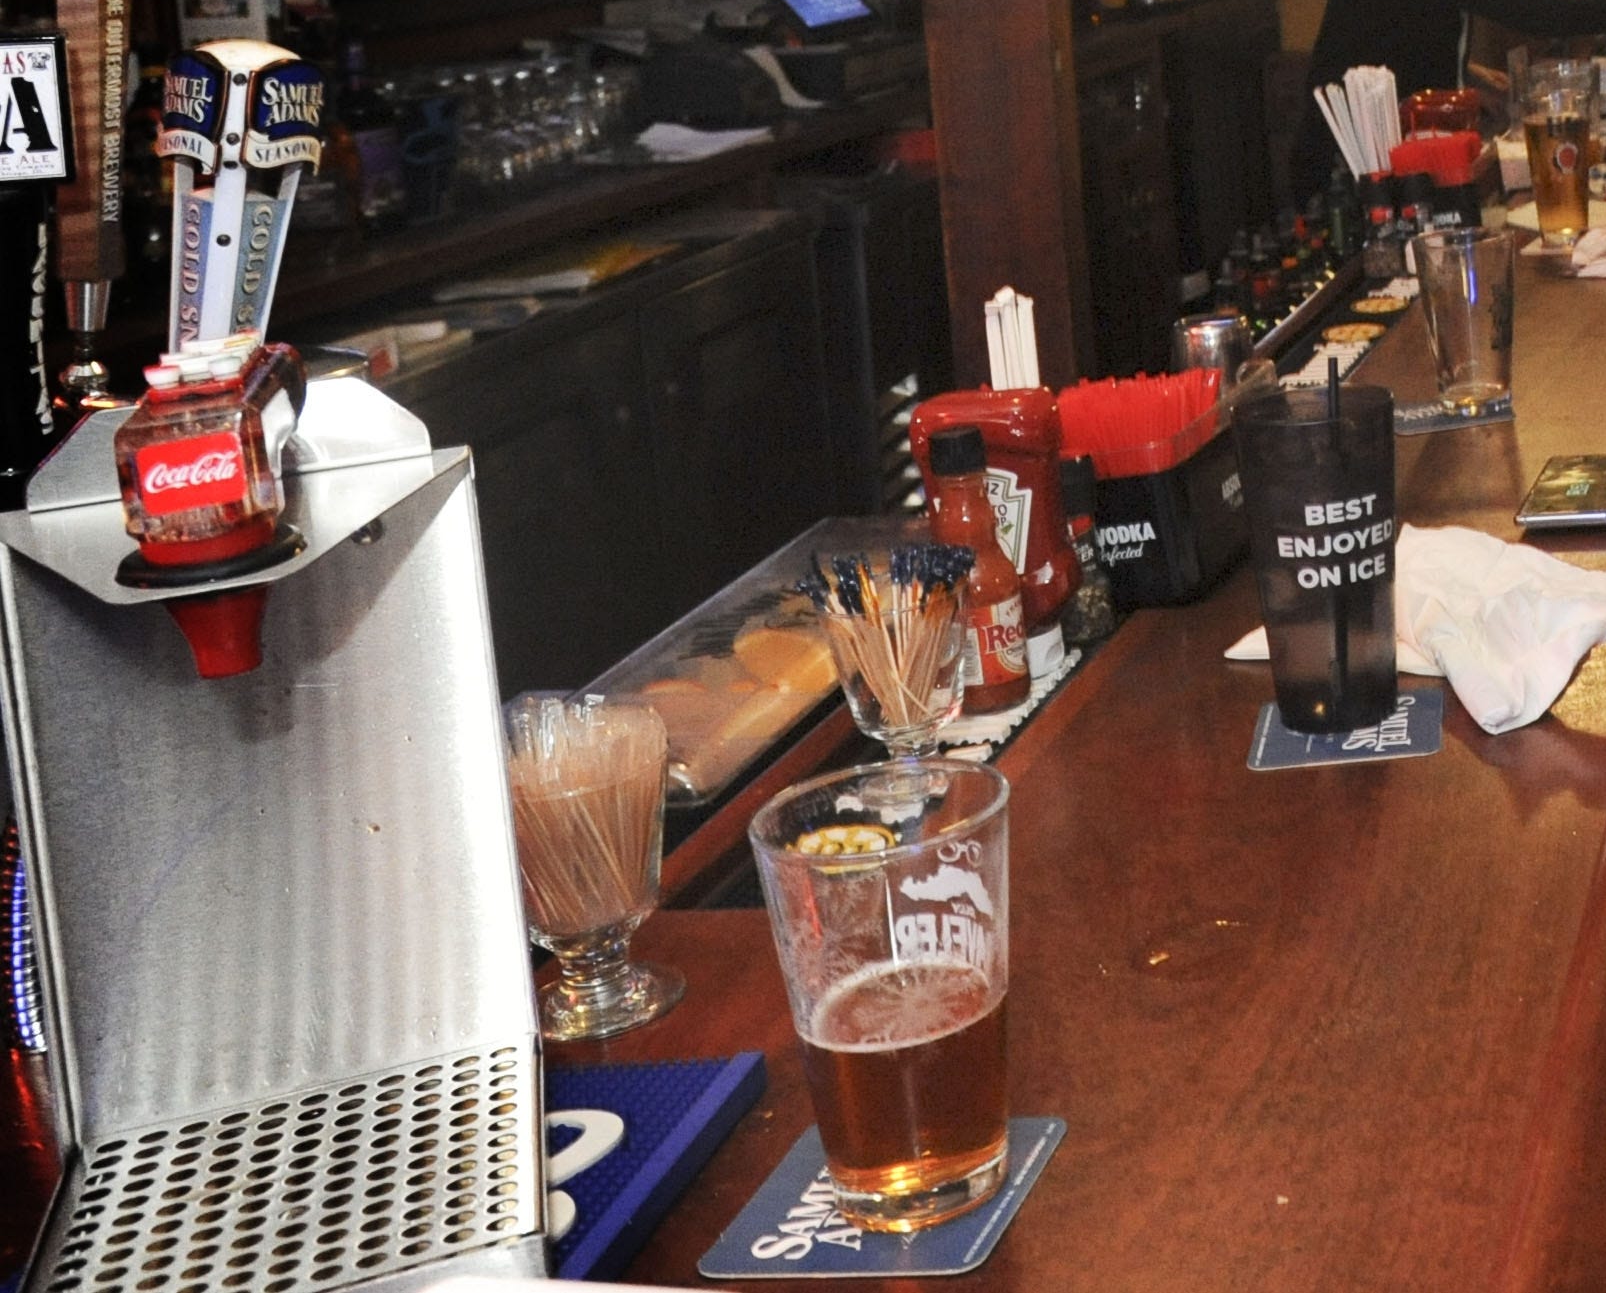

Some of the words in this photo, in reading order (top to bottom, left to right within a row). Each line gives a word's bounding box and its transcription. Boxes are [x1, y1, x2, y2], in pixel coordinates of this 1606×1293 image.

[102, 131, 121, 223] BREWERY
[182, 203, 200, 294] COLD
[243, 204, 273, 294] COLD
[1304, 493, 1377, 526] BEST
[1095, 521, 1157, 547] VODKA
[1277, 518, 1393, 558] ENJOYED
[1297, 565, 1341, 589] ON
[1349, 552, 1386, 583] ICE
